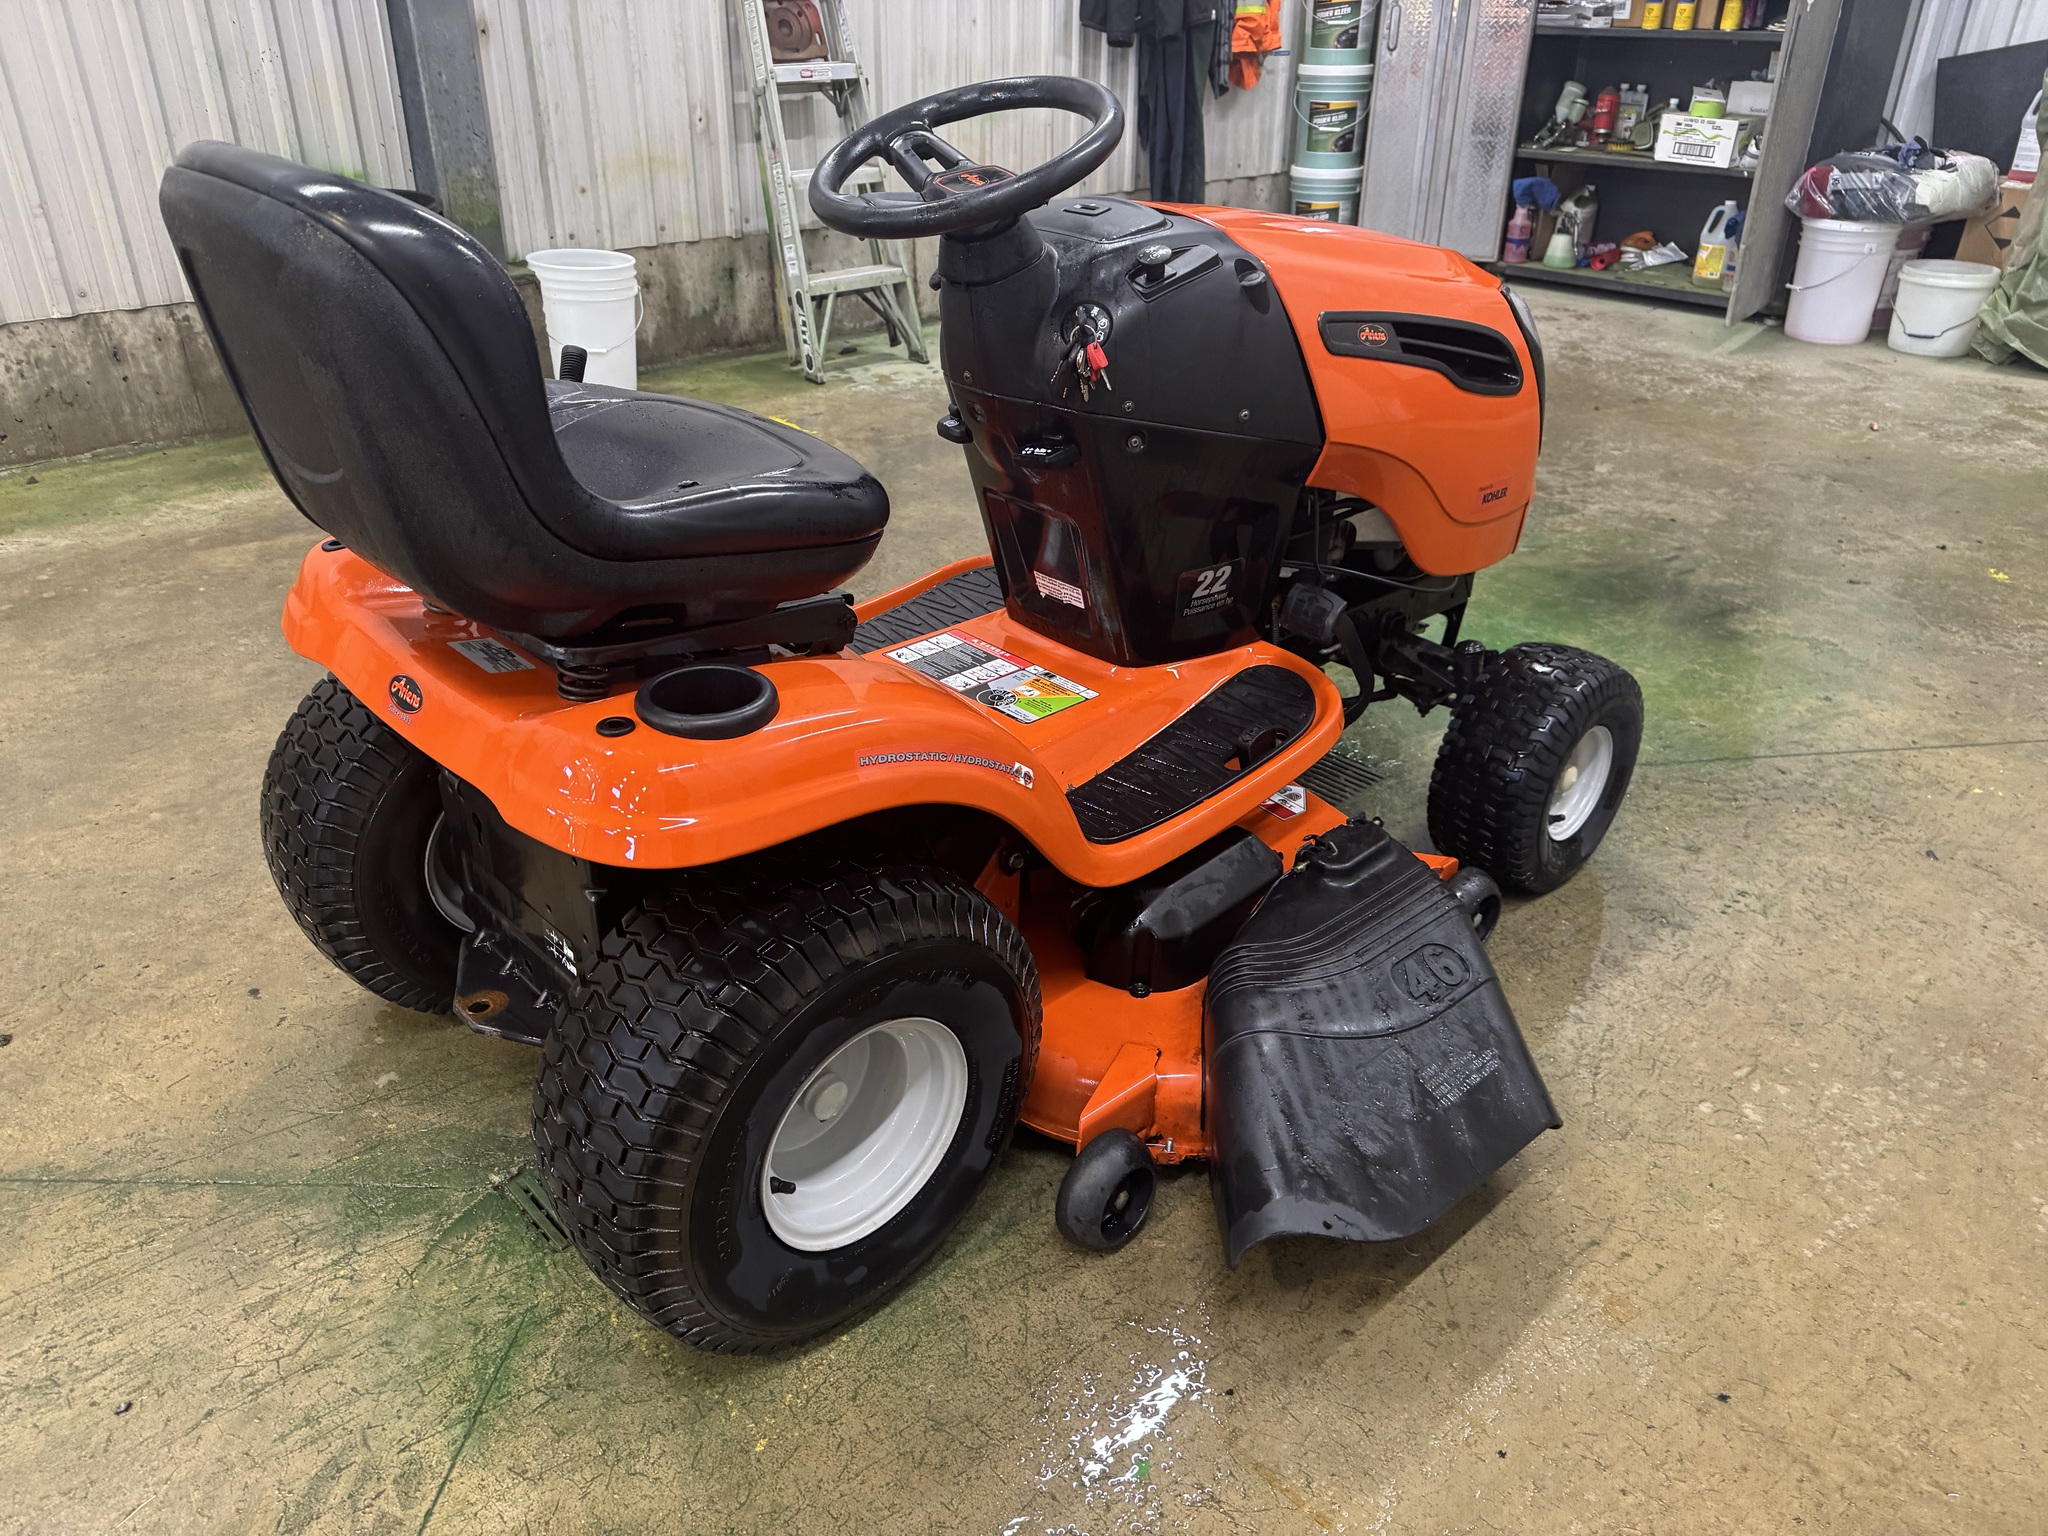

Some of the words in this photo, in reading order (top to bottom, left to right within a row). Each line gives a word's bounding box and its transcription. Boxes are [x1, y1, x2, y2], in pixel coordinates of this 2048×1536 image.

[1359, 326, 1386, 341] Ariens
[1481, 487, 1508, 505] KOHLER
[1191, 565, 1232, 599] 22
[1190, 592, 1228, 607] Horsepower
[1182, 602, 1216, 617] Puissance
[391, 677, 421, 709] Ariens
[1403, 945, 1463, 1003] 46
